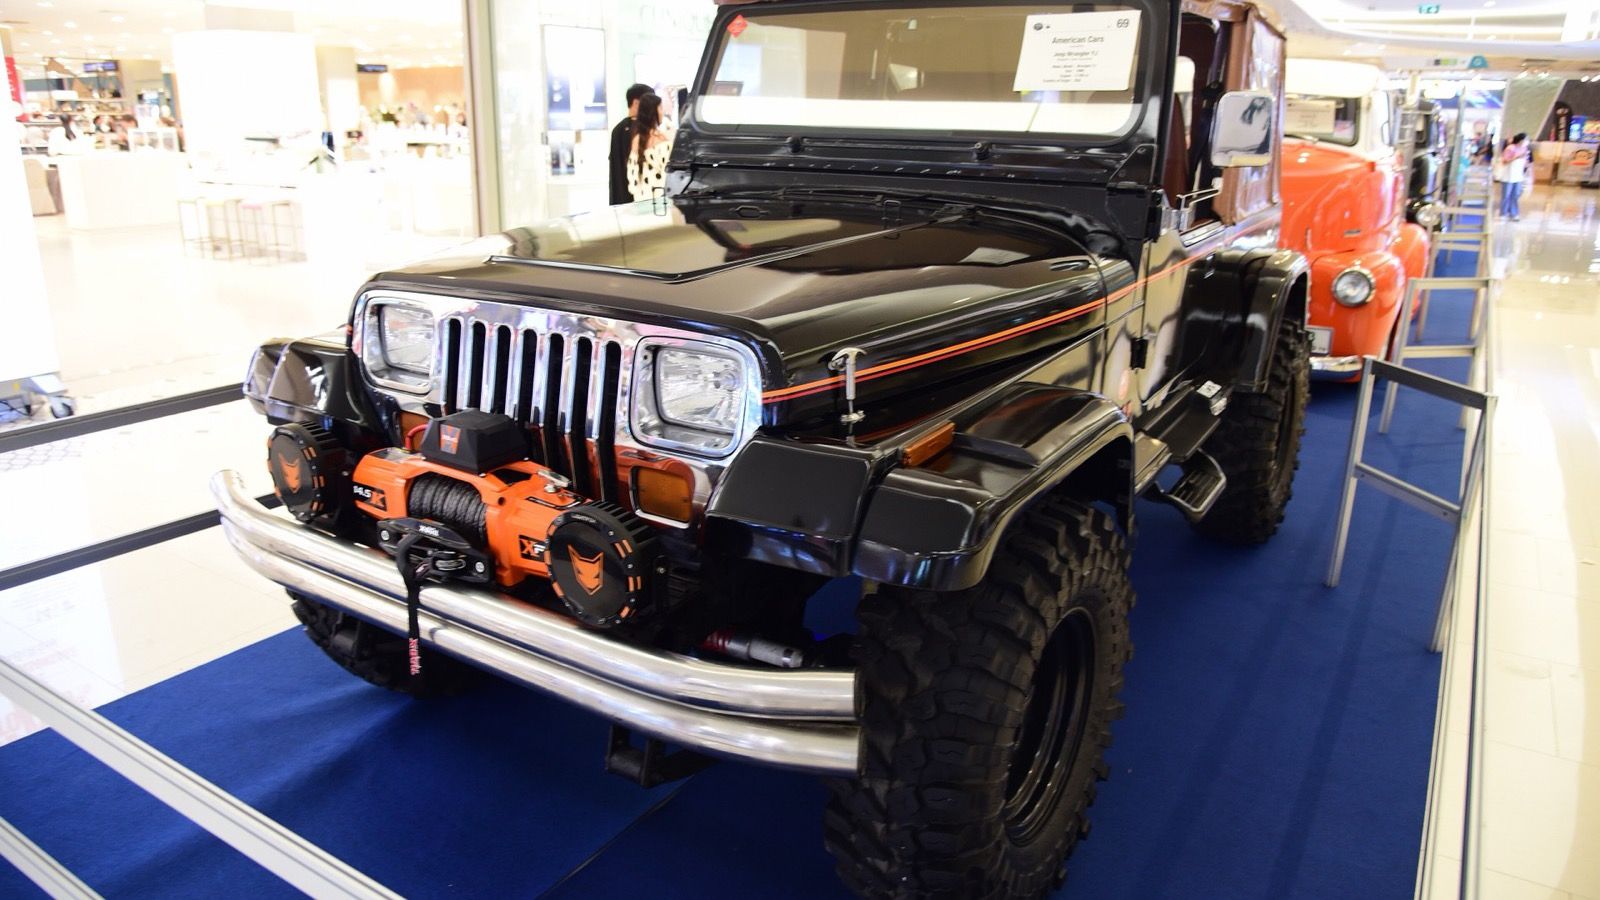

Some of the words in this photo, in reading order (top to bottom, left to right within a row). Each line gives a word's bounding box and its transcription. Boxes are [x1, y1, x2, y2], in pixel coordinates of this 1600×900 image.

[1116, 18, 1130, 29] 69
[1051, 36, 1086, 44] American
[1087, 35, 1104, 43] Cars
